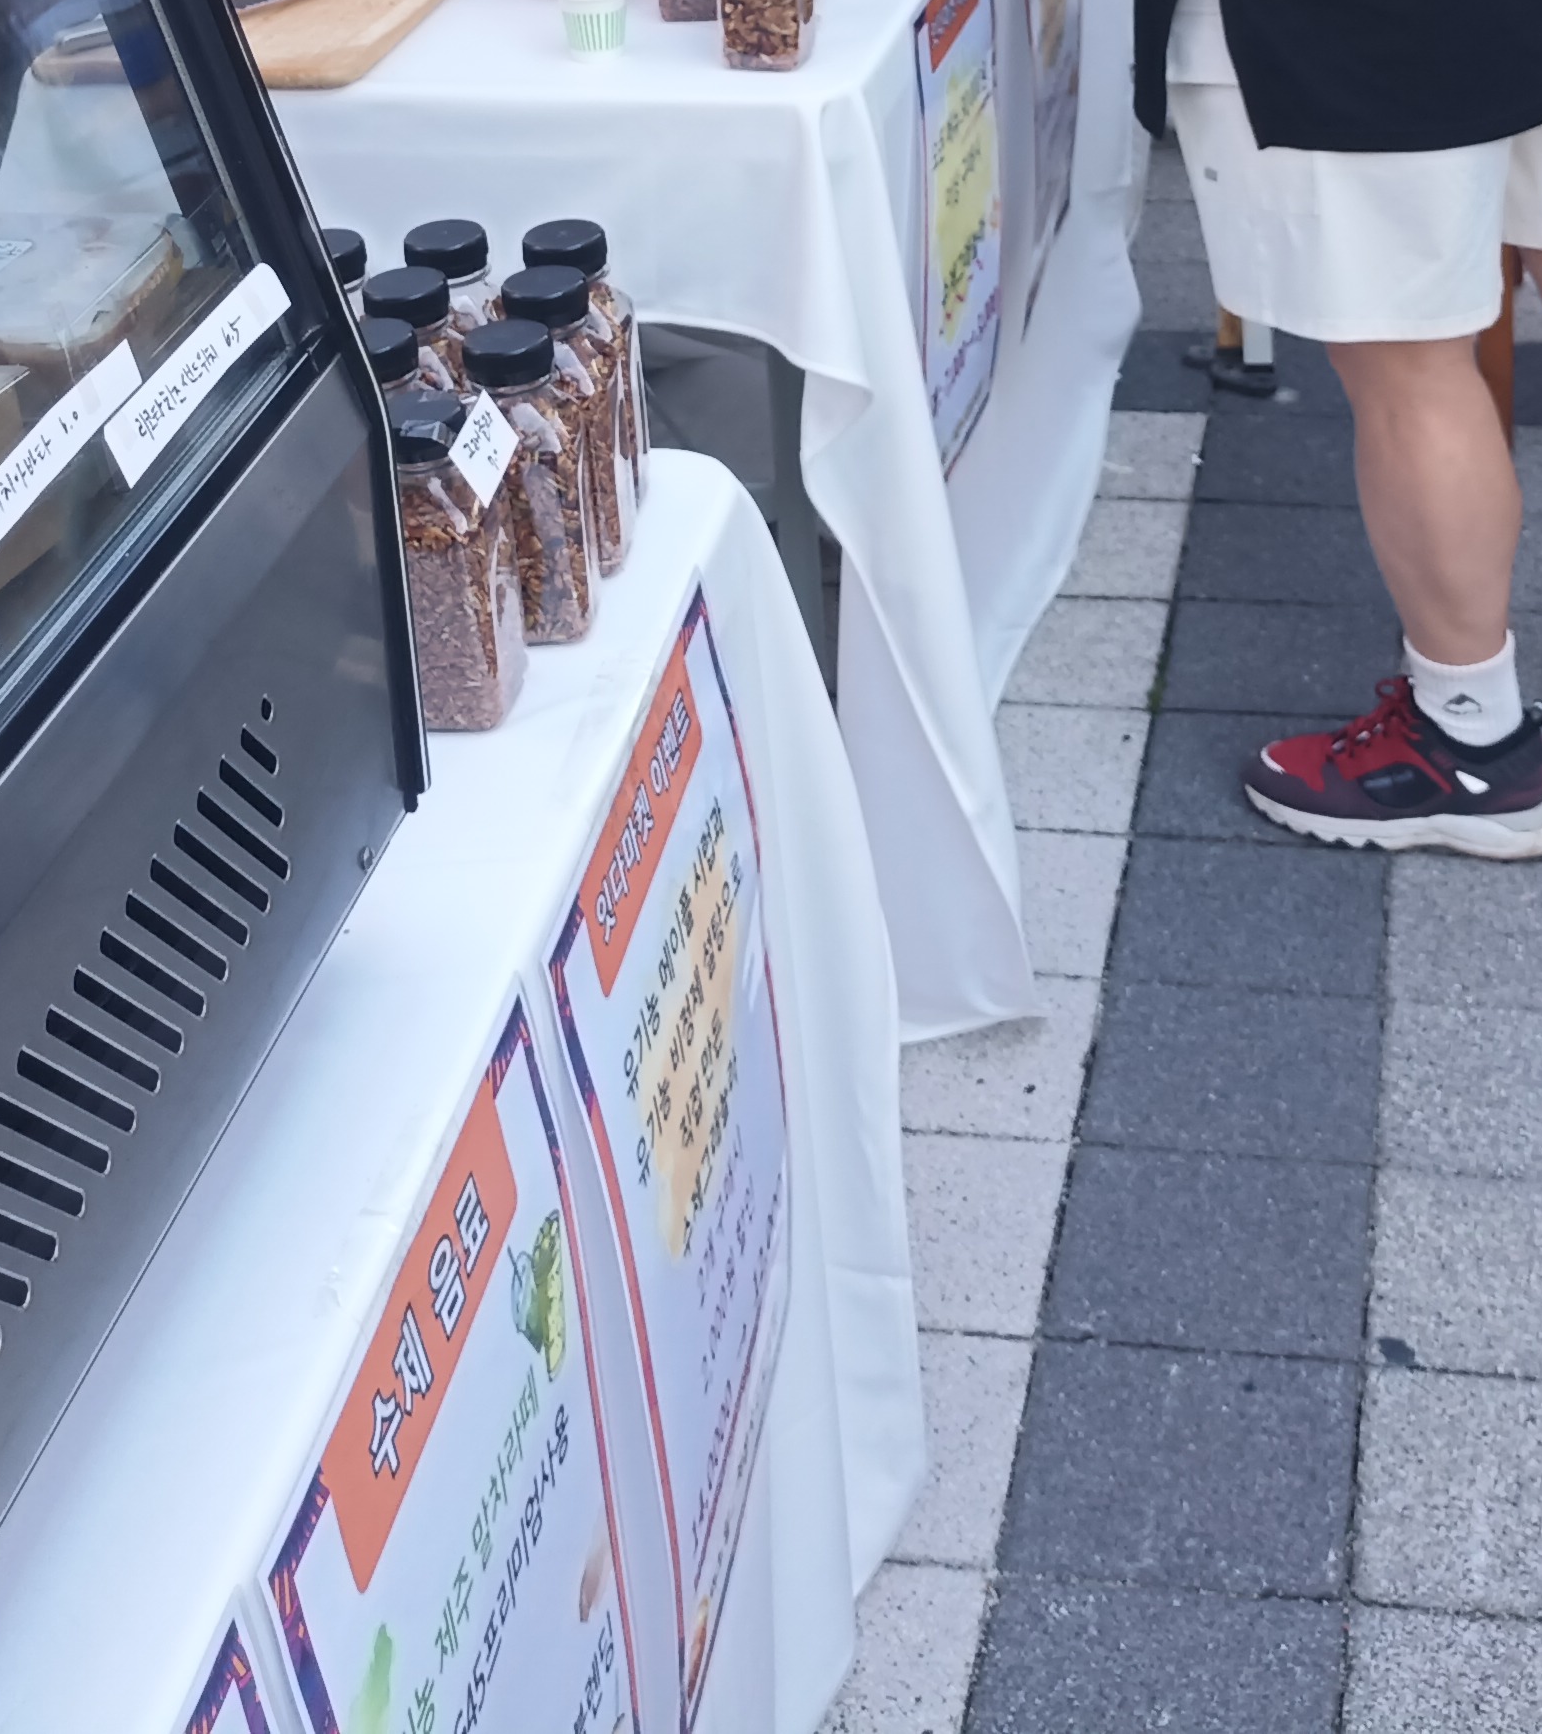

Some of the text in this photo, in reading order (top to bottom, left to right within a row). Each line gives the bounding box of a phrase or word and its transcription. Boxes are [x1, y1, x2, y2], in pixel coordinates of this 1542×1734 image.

[220, 315, 242, 348] 6.5
[594, 688, 691, 946] 잇다마켓 이벤트
[624, 795, 725, 1100] 유기농 메이플 시럽과
[636, 850, 743, 1188] 유기농 비정제 설탕으로
[368, 1170, 491, 1480] 수제 음료
[434, 1554, 474, 1675] 제주
[471, 1363, 540, 1572] 말차라떼
